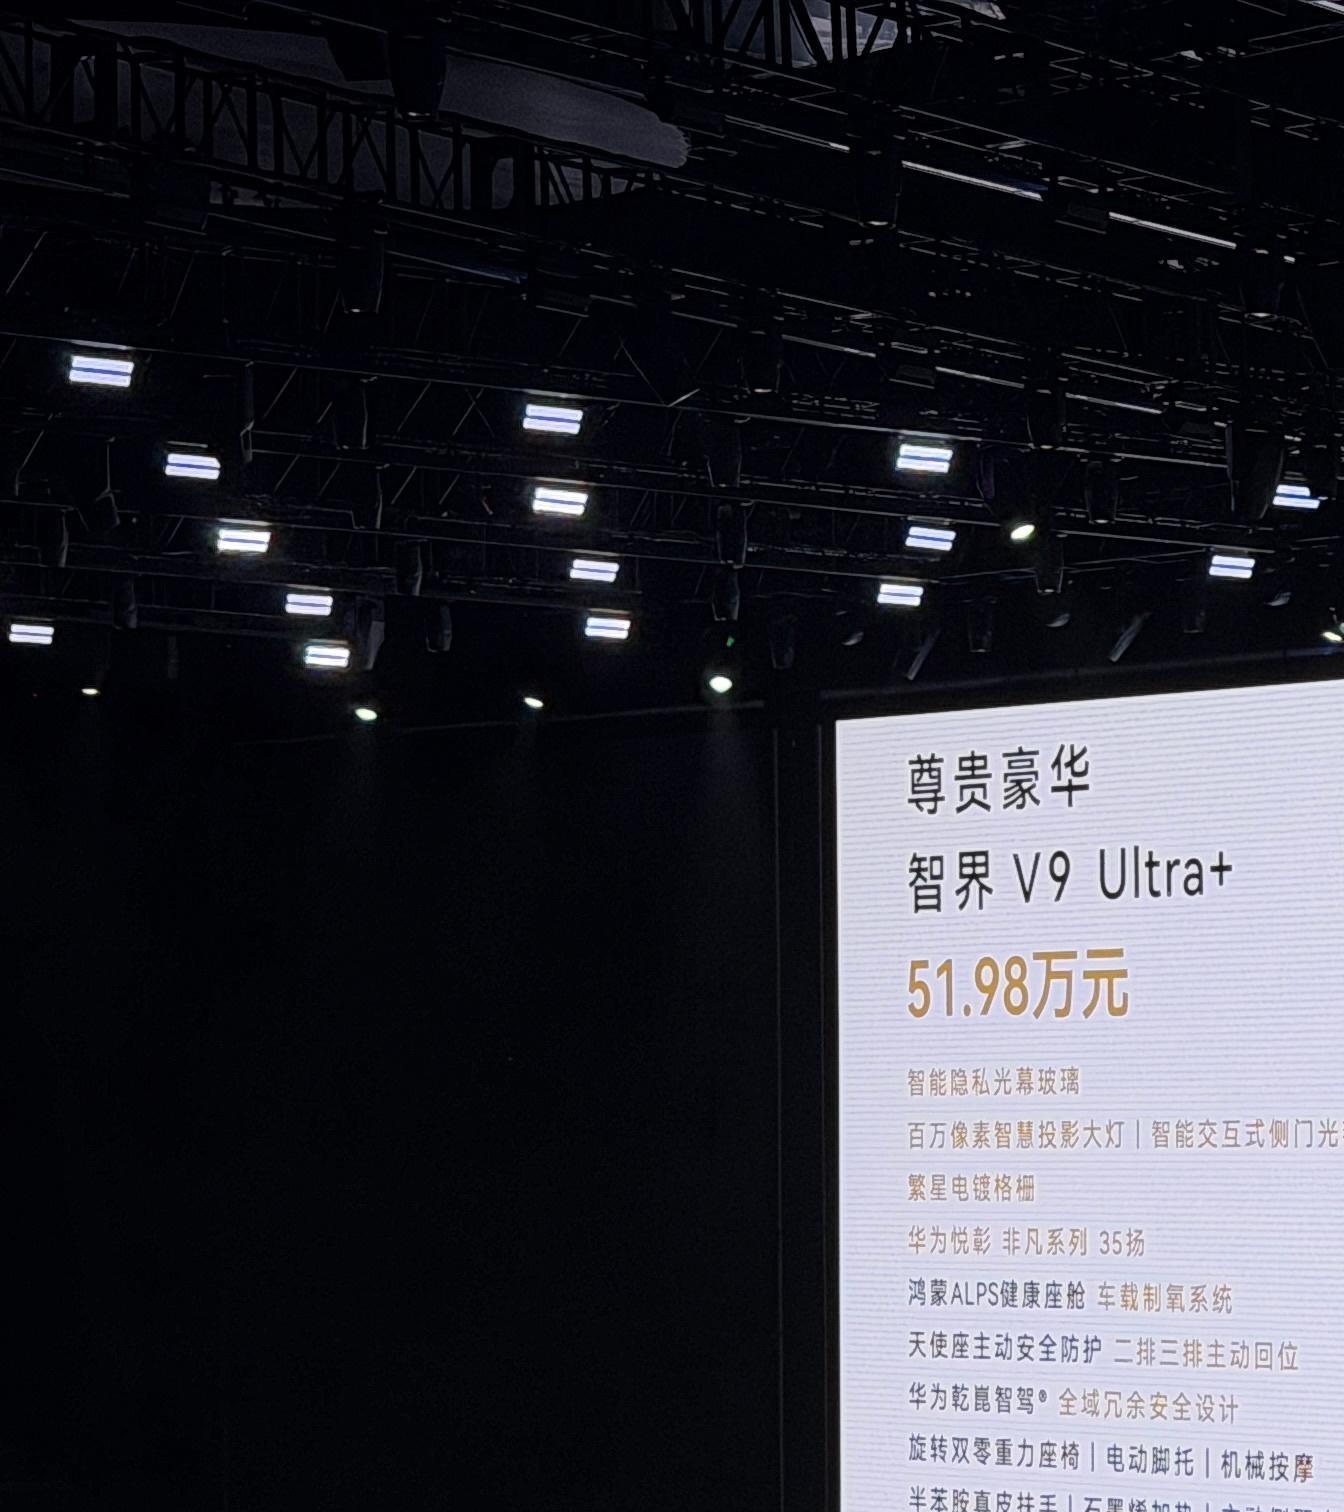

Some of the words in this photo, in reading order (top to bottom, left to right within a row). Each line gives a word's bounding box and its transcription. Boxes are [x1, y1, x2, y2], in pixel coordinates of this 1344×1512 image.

[907, 743, 1090, 815] 尊贵豪华
[908, 849, 994, 914] 智界
[1012, 850, 1071, 904] V9
[1099, 844, 1233, 900] Ultra+
[908, 947, 1129, 1020] 51.98万元
[908, 1066, 1079, 1097] 智能隐私光幕玻璃
[907, 1119, 1125, 1149] 百万像素智慧投影大灯
[908, 1173, 1035, 1202] 繁星电镀格栅
[908, 1225, 991, 1255] 华为悦彰
[1002, 1227, 1087, 1256] 非凡系列
[1099, 1227, 1145, 1257] 35扬
[908, 1277, 1086, 1310] 鸿蒙ALPS健康座舱
[1097, 1281, 1233, 1314] 车载制氧系统
[908, 1330, 1102, 1364] 天使座主动安全防护
[1114, 1337, 1299, 1371] 二排三排主动回位
[1058, 1387, 1239, 1423] 全域冗余安全设计
[908, 1433, 1080, 1471] 旋转双零重力座椅
[1106, 1443, 1194, 1477] 电动脚托
[1220, 1449, 1314, 1484] 机械按摩
